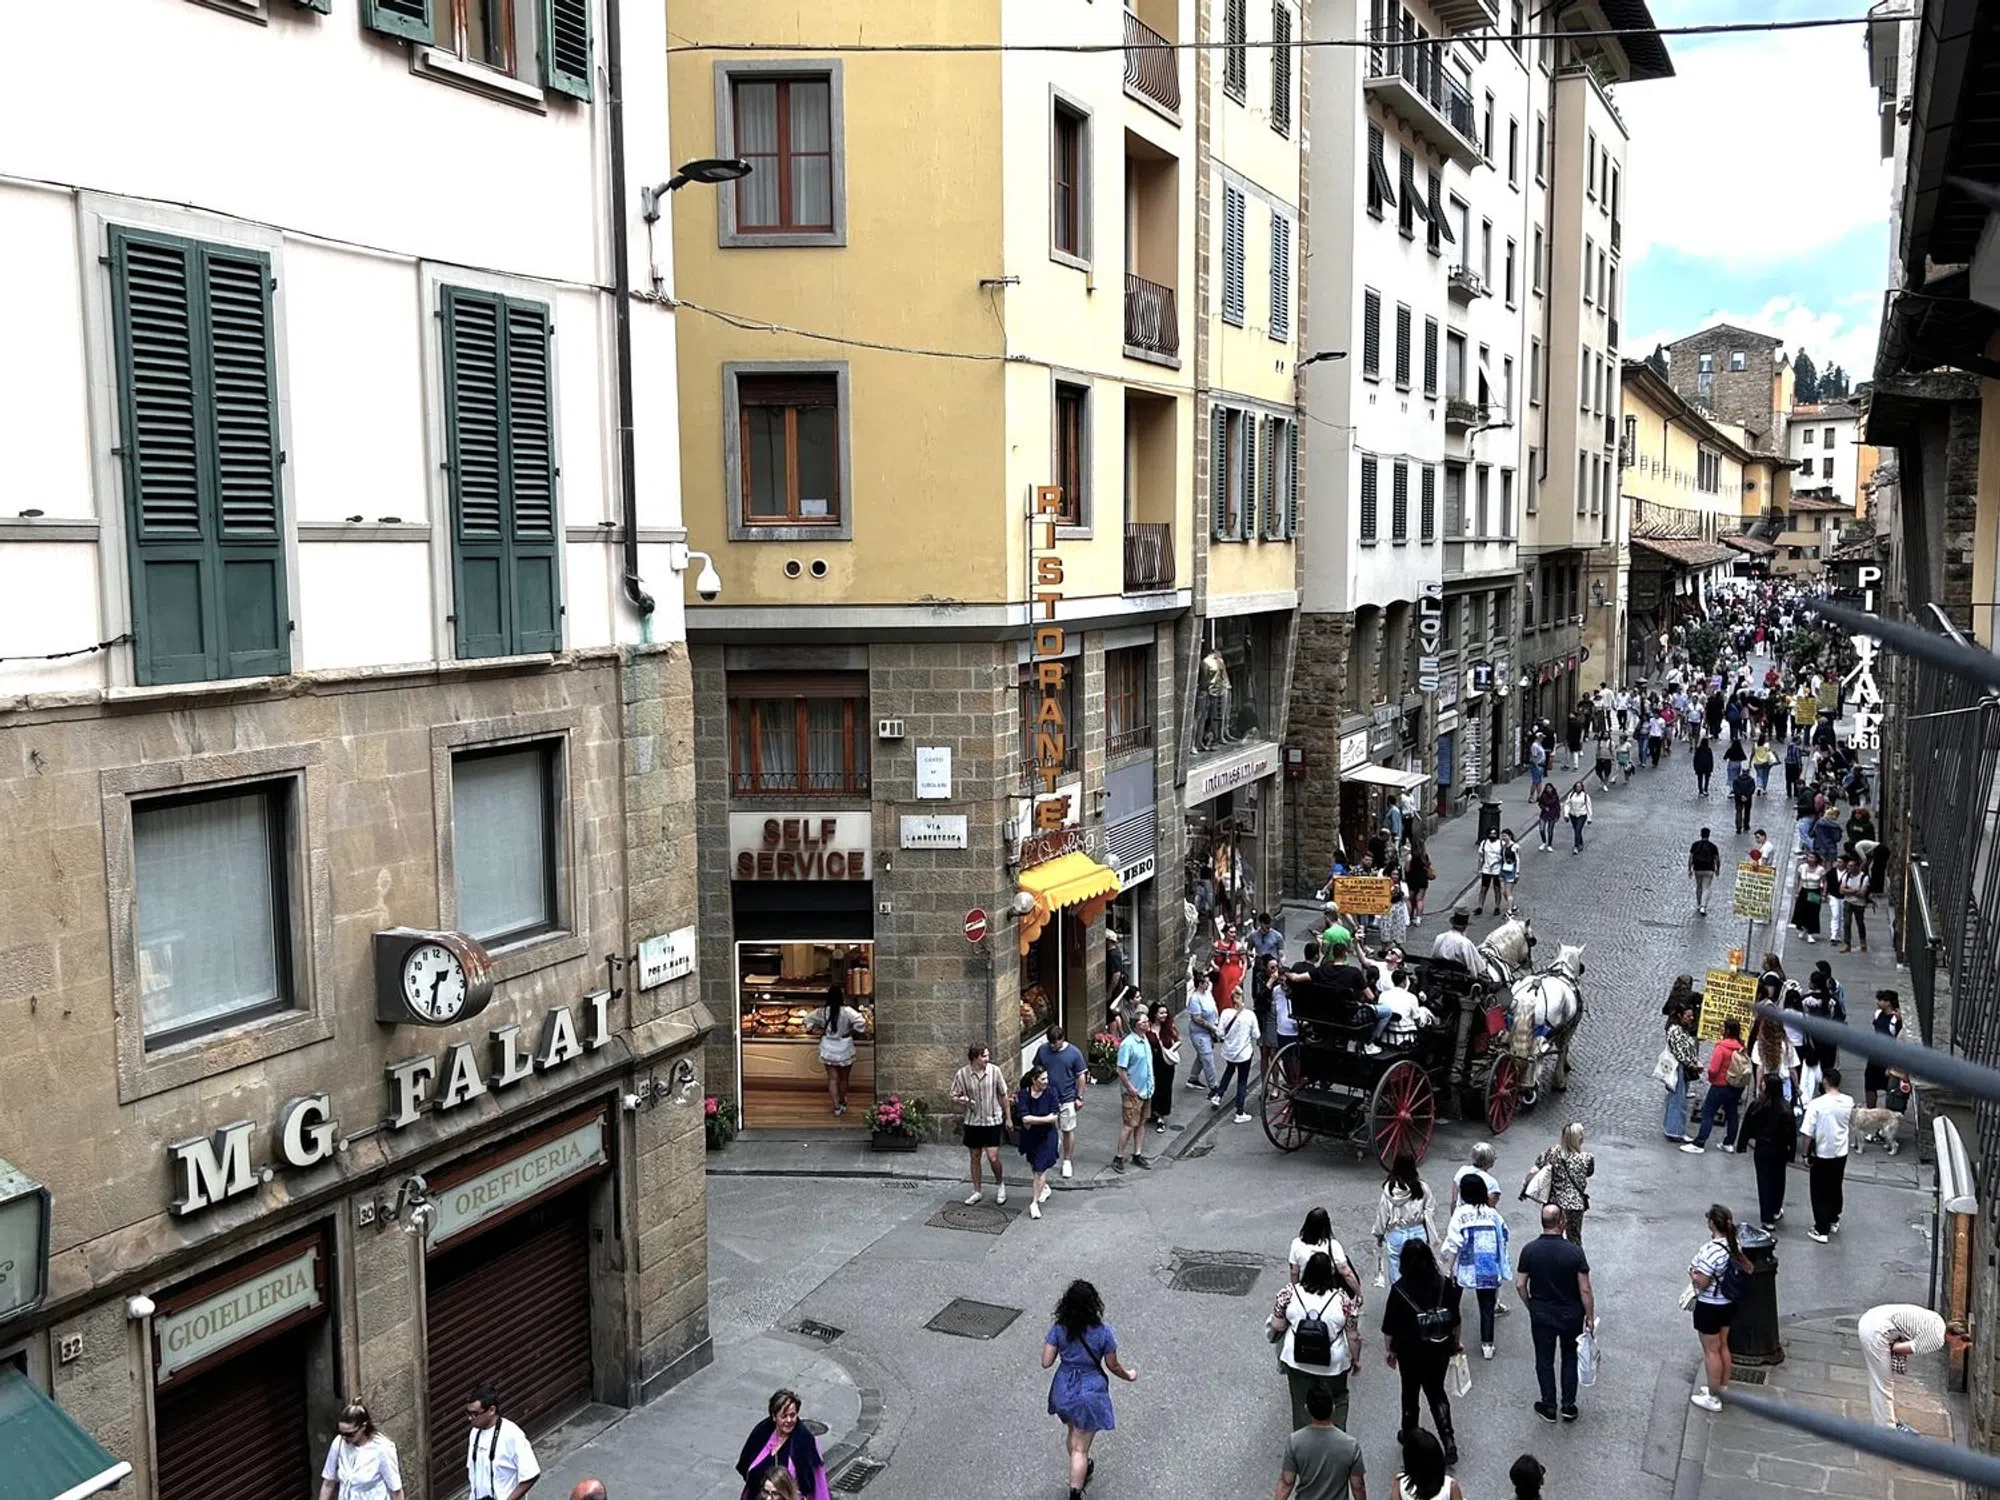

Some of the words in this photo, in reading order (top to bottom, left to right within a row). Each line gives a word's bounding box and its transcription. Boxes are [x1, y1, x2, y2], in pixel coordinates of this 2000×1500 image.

[1418, 583, 1442, 691] GLOVES
[1036, 484, 1065, 831] RISTORANTE
[763, 819, 837, 846] SELF
[906, 834, 961, 842] LAMBERTESCA
[737, 851, 865, 878] SERVICE
[1122, 857, 1153, 883] NERO
[432, 949, 441, 959] 12
[663, 945, 675, 955] VIA
[422, 951, 429, 961] 11
[447, 953, 452, 964] 1
[414, 961, 423, 971] 10
[670, 955, 690, 969] MARIA
[455, 964, 462, 975] 2
[411, 974, 417, 985] 9
[459, 979, 466, 990] 3
[415, 988, 421, 999] 8
[457, 993, 463, 1003] 4
[424, 1000, 431, 1011] 7
[436, 1005, 443, 1016] 6
[447, 1002, 454, 1013] 5
[385, 991, 612, 1129] FALAI
[456, 1141, 581, 1215] OREFICERIA
[361, 1206, 373, 1220] 30
[168, 1269, 308, 1352] GIOIELLERIA
[63, 1338, 81, 1358] 32
